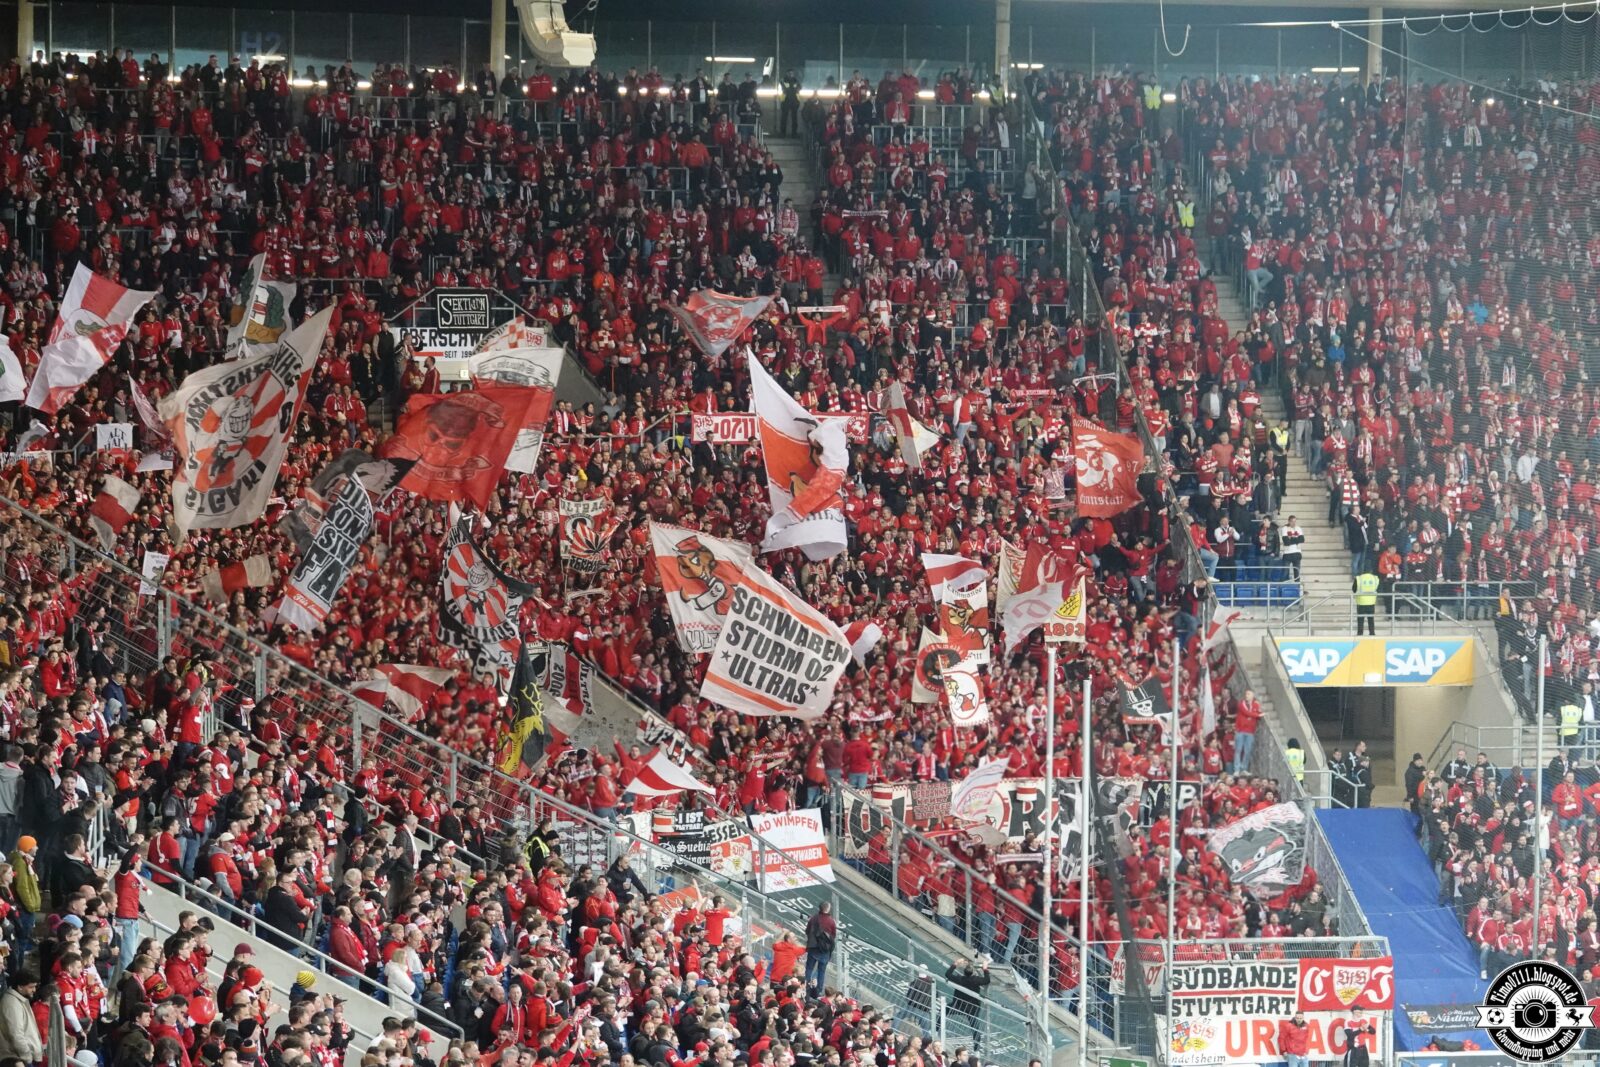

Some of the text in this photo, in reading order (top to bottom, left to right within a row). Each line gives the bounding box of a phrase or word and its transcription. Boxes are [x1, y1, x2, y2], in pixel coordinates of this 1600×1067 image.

[731, 585, 849, 665] SCHWABEN
[1043, 622, 1086, 637] 1893
[725, 620, 834, 682] STURM 02
[1280, 648, 1340, 676] SAP
[1385, 648, 1446, 676] SAP
[728, 653, 811, 705] ULTRAS
[773, 815, 819, 833] WIMPFEN
[755, 851, 783, 866] SAUFER
[1172, 966, 1298, 989] SÜDBANDE
[1172, 996, 1296, 1016] STUTTGART
[1225, 1016, 1377, 1058] URACH
[1158, 1053, 1226, 1064] Gndelsheim
